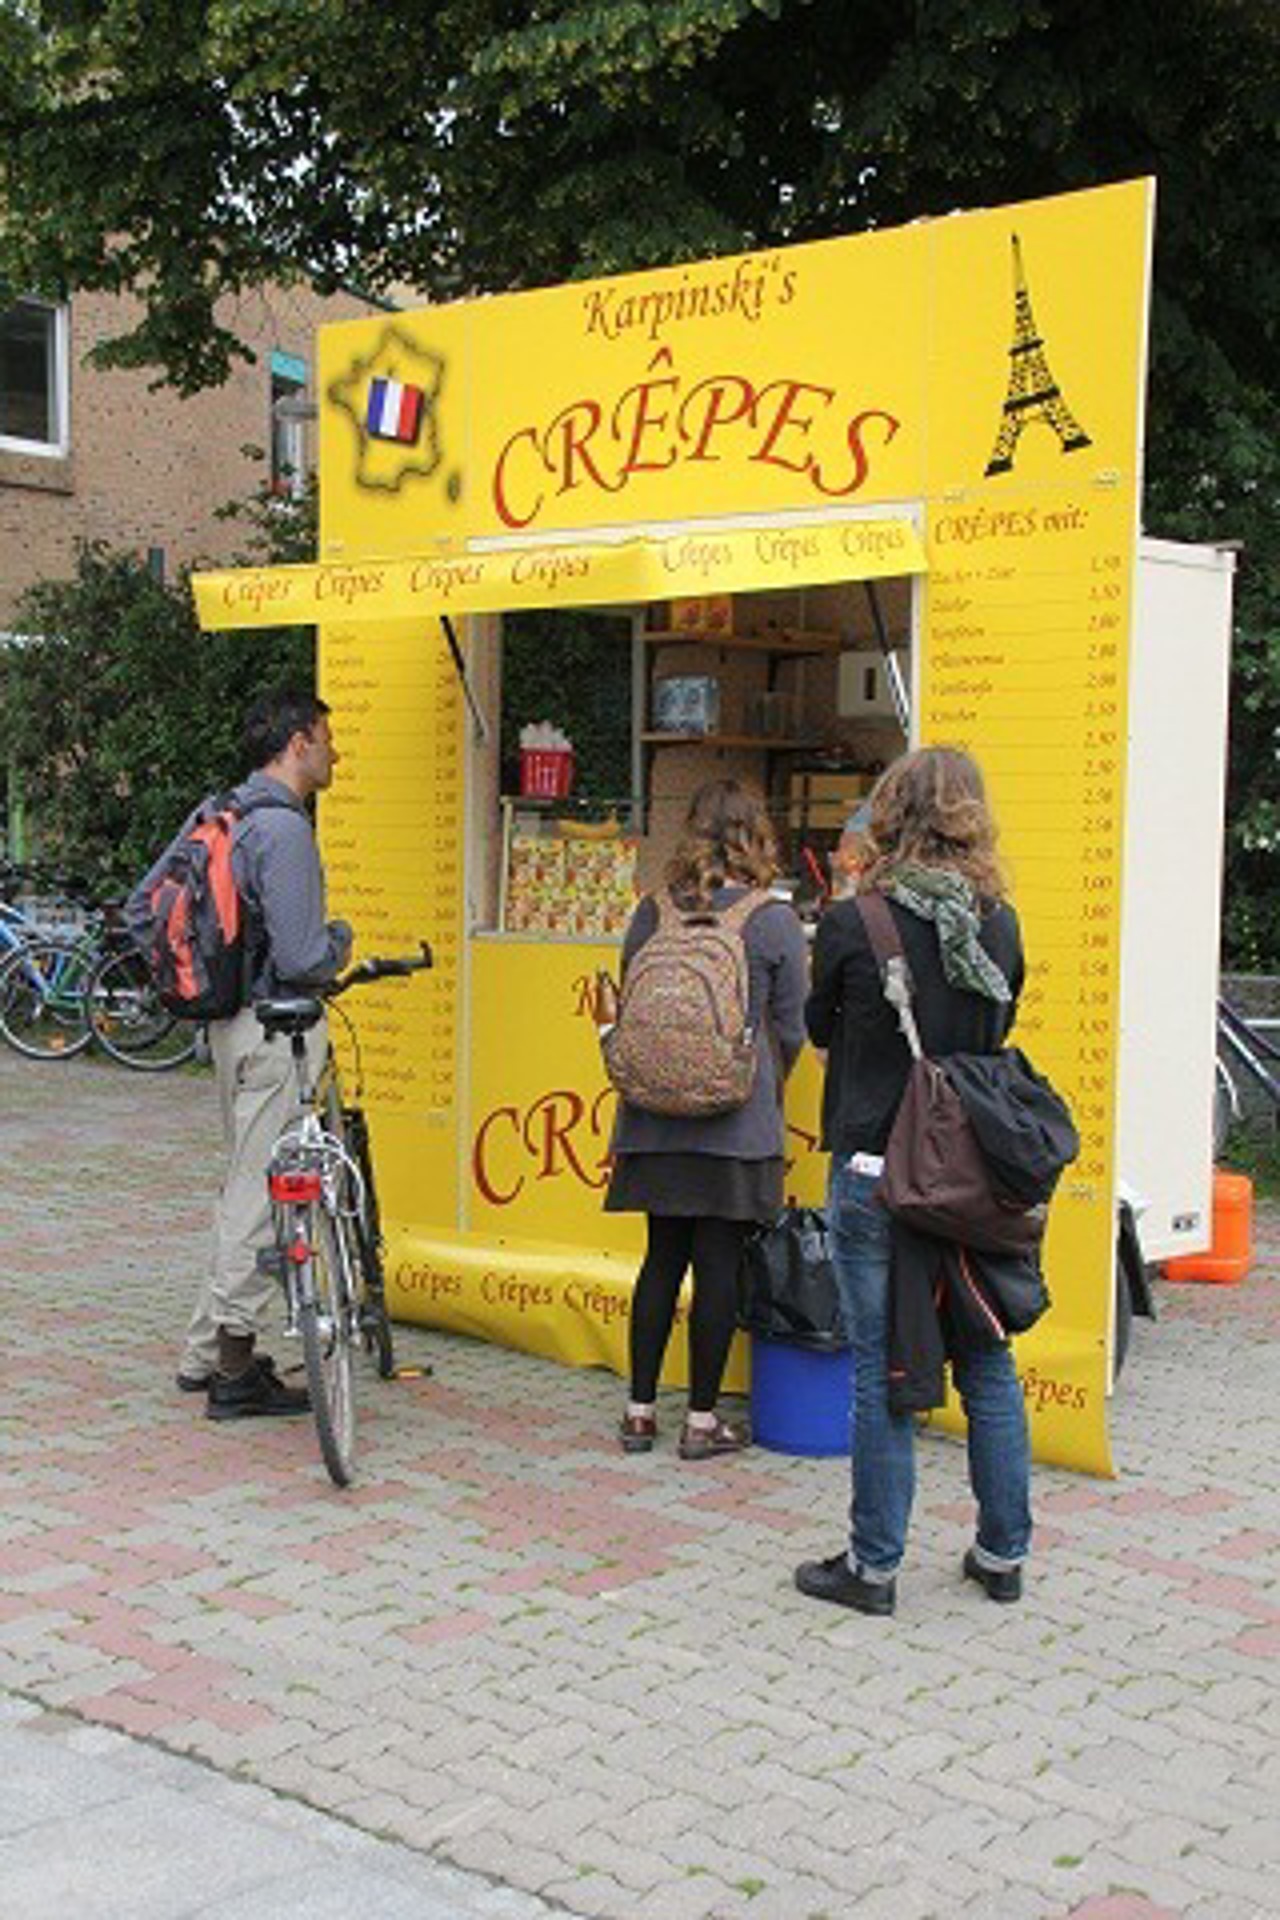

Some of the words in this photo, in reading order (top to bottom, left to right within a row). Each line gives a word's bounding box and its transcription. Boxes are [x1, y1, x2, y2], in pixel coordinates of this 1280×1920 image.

[583, 257, 797, 340] Karpinski's
[493, 346, 901, 529] CRÊPES
[662, 538, 732, 577] Crêpes
[755, 530, 820, 569] Crêpes
[843, 523, 904, 560] Crêpes
[223, 572, 291, 611] Crêpes
[315, 566, 384, 603] Crêpes
[410, 558, 484, 596] Crêpes
[511, 551, 590, 589] Crêpes
[396, 1263, 461, 1300] Crêpes
[480, 1271, 552, 1311] Crêpes
[564, 1282, 629, 1324] Crêpe
[1020, 1367, 1087, 1412] êpes
